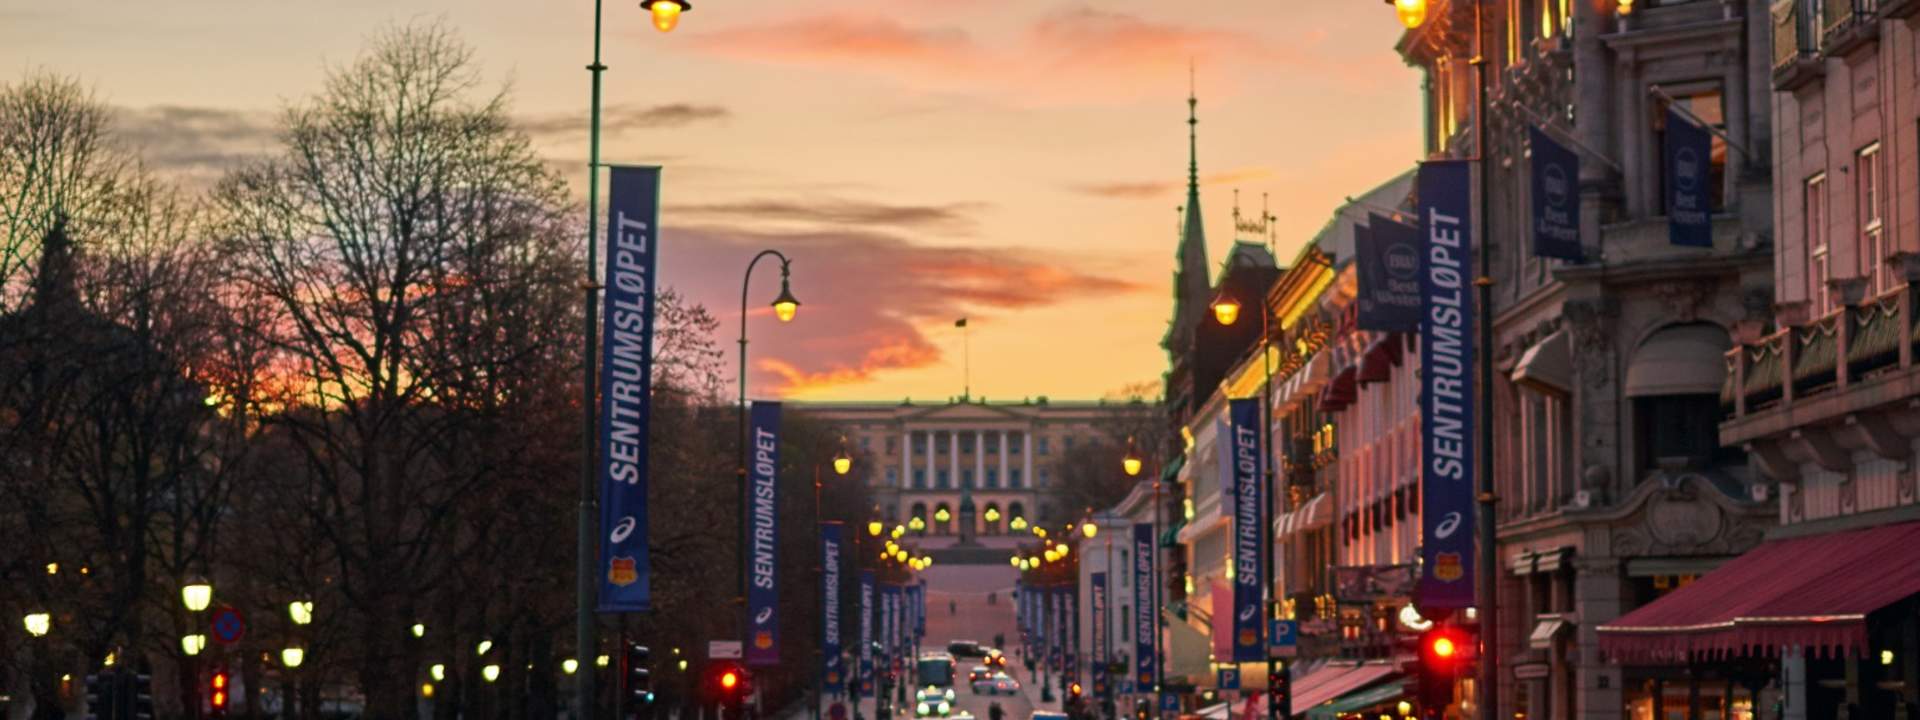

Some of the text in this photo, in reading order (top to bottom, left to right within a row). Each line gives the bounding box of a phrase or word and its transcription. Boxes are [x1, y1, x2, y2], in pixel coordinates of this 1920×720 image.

[609, 211, 648, 485] SENTRUMSLØPET
[1429, 206, 1464, 480] SENTRUMSLØPET
[754, 427, 776, 590] SENTRUMSLØPET
[1236, 424, 1258, 586] SENTRUMSLØPET
[1223, 671, 1235, 686] P
[1275, 623, 1289, 643] P
